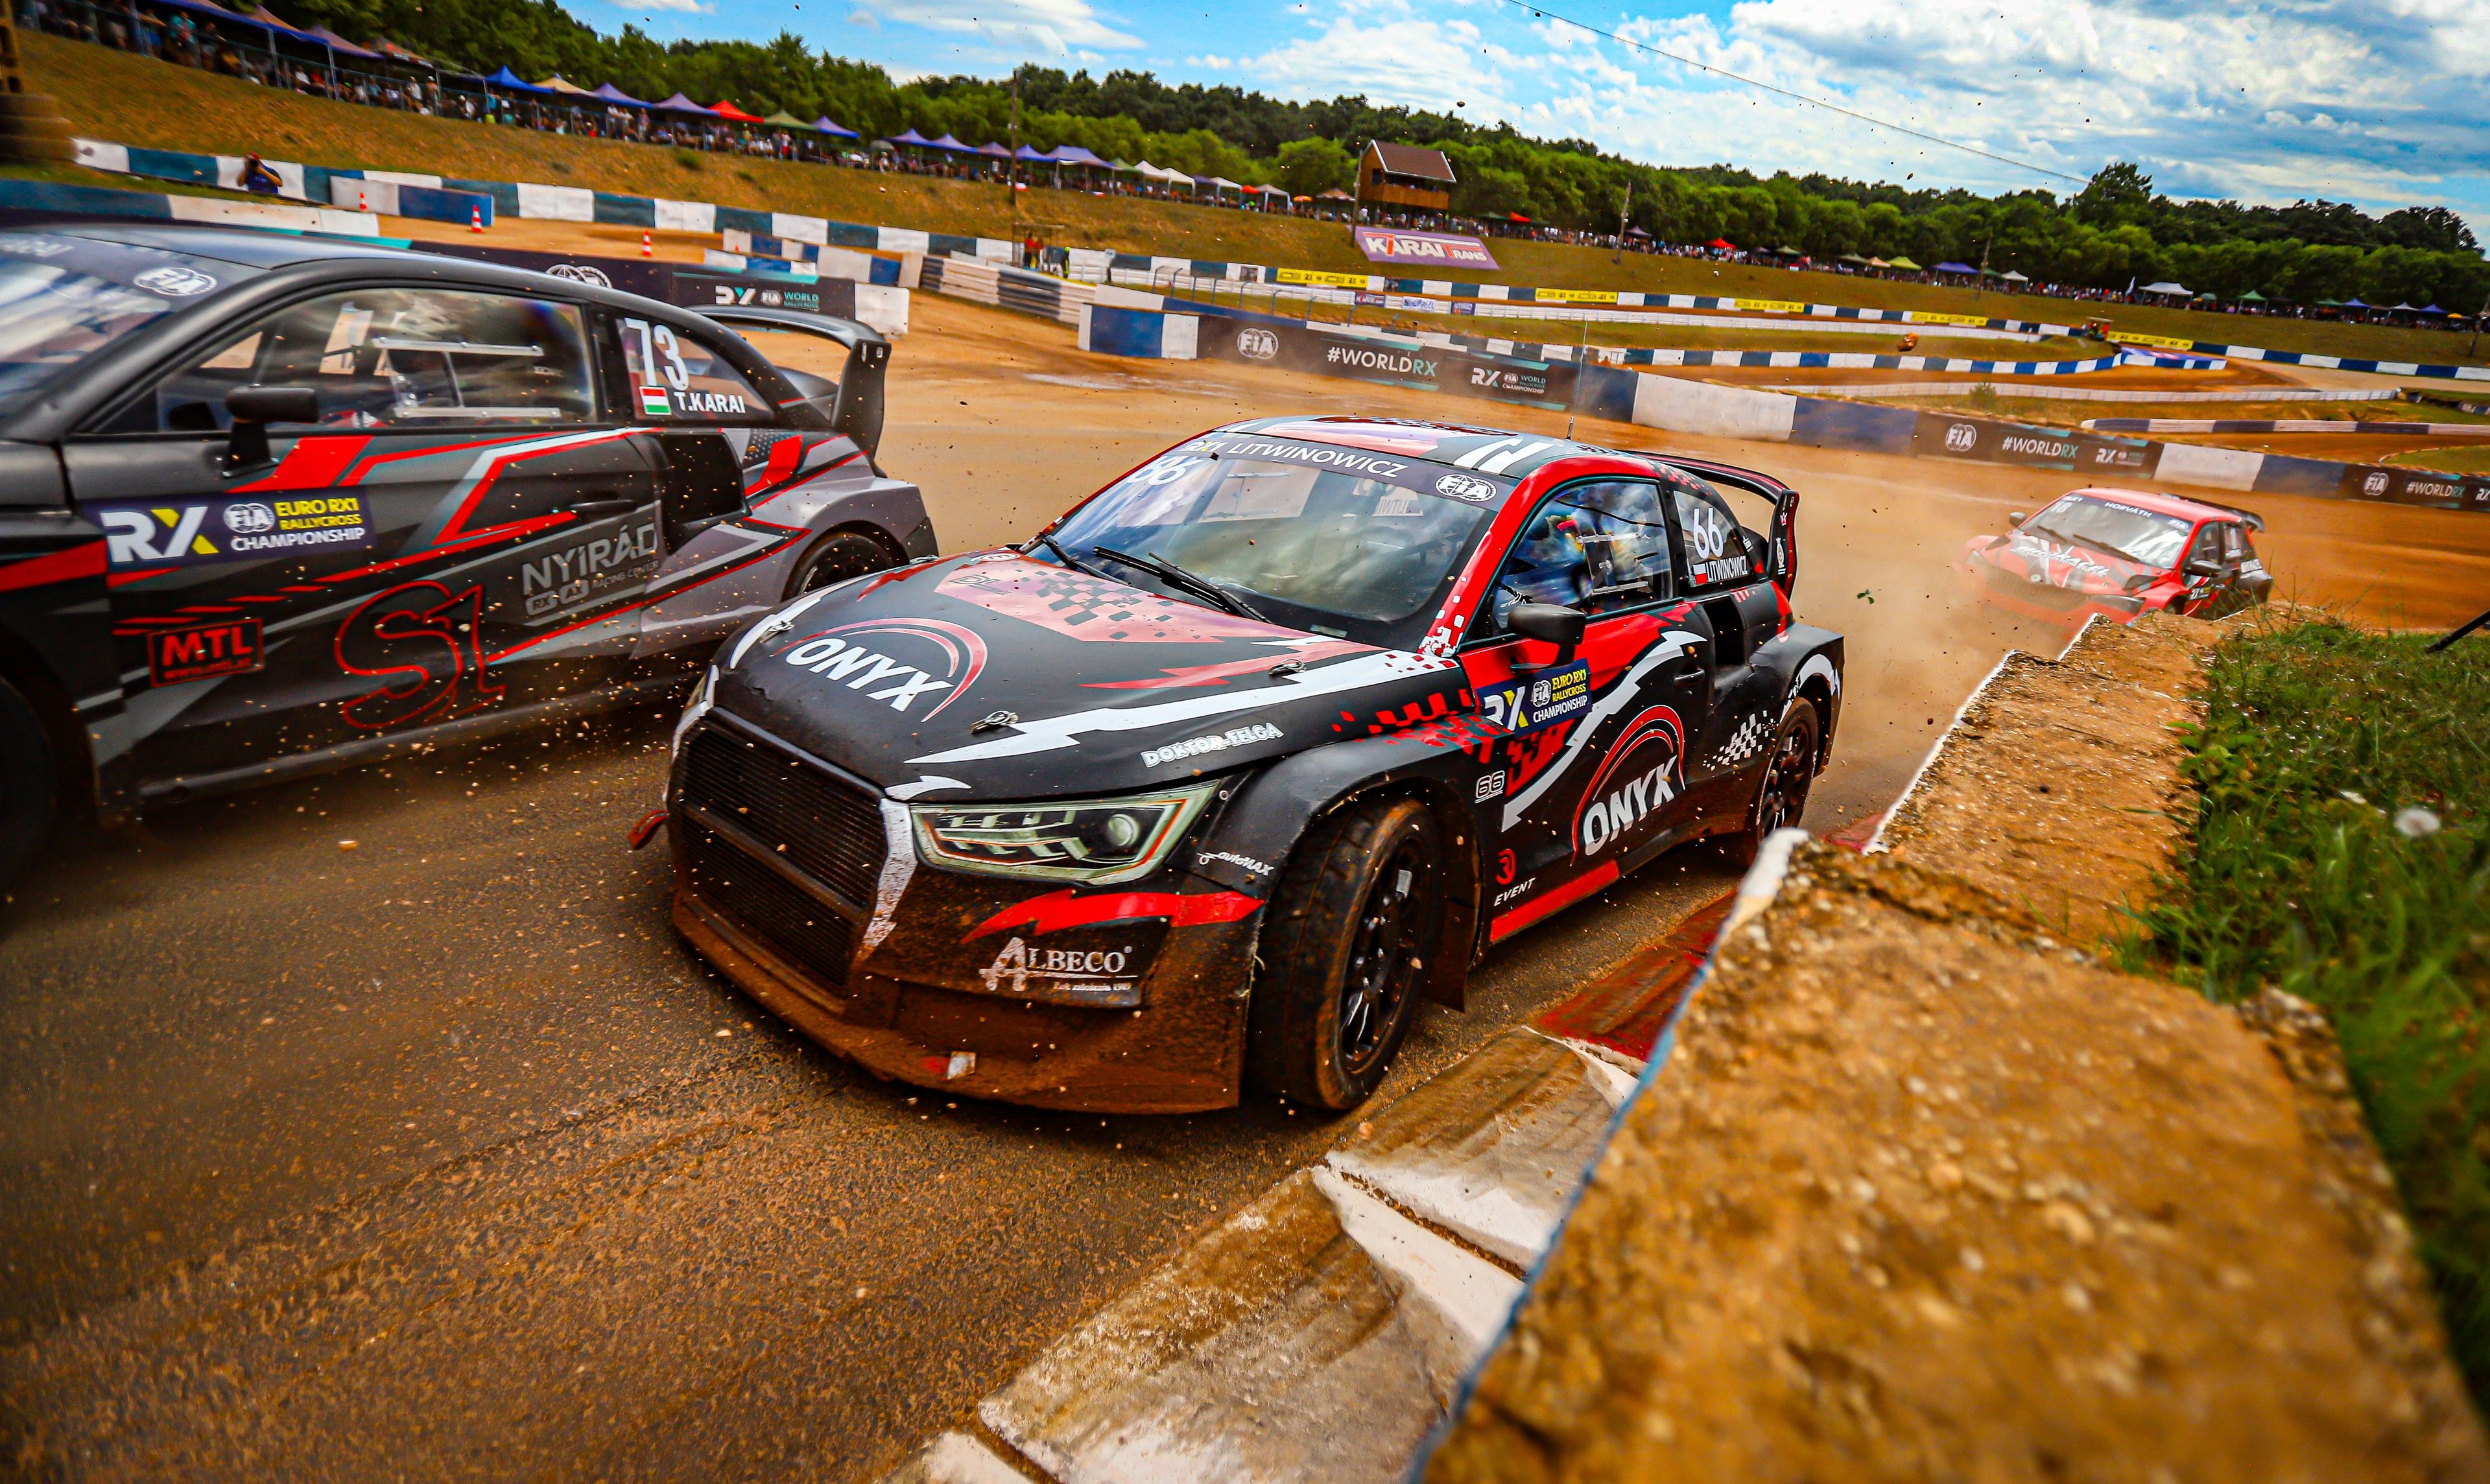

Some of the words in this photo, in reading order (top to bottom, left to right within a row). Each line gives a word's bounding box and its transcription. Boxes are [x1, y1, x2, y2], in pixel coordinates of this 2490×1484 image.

[784, 292, 820, 301] WORLD
[624, 317, 689, 390] 73
[1239, 331, 1276, 355] FIA
[1327, 347, 1438, 377] #WORLDRX
[1471, 368, 1501, 387] RX
[1521, 375, 1546, 384] WORLD
[1502, 383, 1545, 394] CHAMPIONSHIP
[674, 392, 746, 414] T.KARAI
[1947, 425, 1974, 448] FIA
[2002, 436, 2079, 458] #WORLDRX
[1178, 441, 1228, 453] RX1
[1226, 443, 1408, 478] LITWINOWICZ
[1437, 476, 1490, 500] FIA
[2365, 474, 2388, 493] FIA
[2406, 482, 2465, 498] #WORLDRX
[100, 506, 219, 563] RX
[226, 506, 274, 529] FIA
[274, 499, 326, 517] EURO
[327, 497, 359, 513] RX1
[279, 514, 363, 530] RALLYCROSS
[1693, 507, 1724, 559] 66
[230, 527, 366, 551] CHAMPIONSHIP
[1705, 556, 1749, 582] LITWINOWICZ
[163, 626, 254, 667] MTL
[786, 637, 954, 713] ONYX
[1484, 686, 1529, 731] RX
[1532, 683, 1550, 703] FIA
[1552, 673, 1573, 690] EURO
[1572, 669, 1587, 683] RX1
[1552, 683, 1587, 702] RALLYCROSS
[1533, 695, 1587, 723] CHAMPIONSHIP
[1475, 770, 1506, 799] 66
[1583, 755, 1678, 856] ONYX
[1493, 877, 1536, 906] EVENT
[978, 937, 1126, 992] ALBECO
